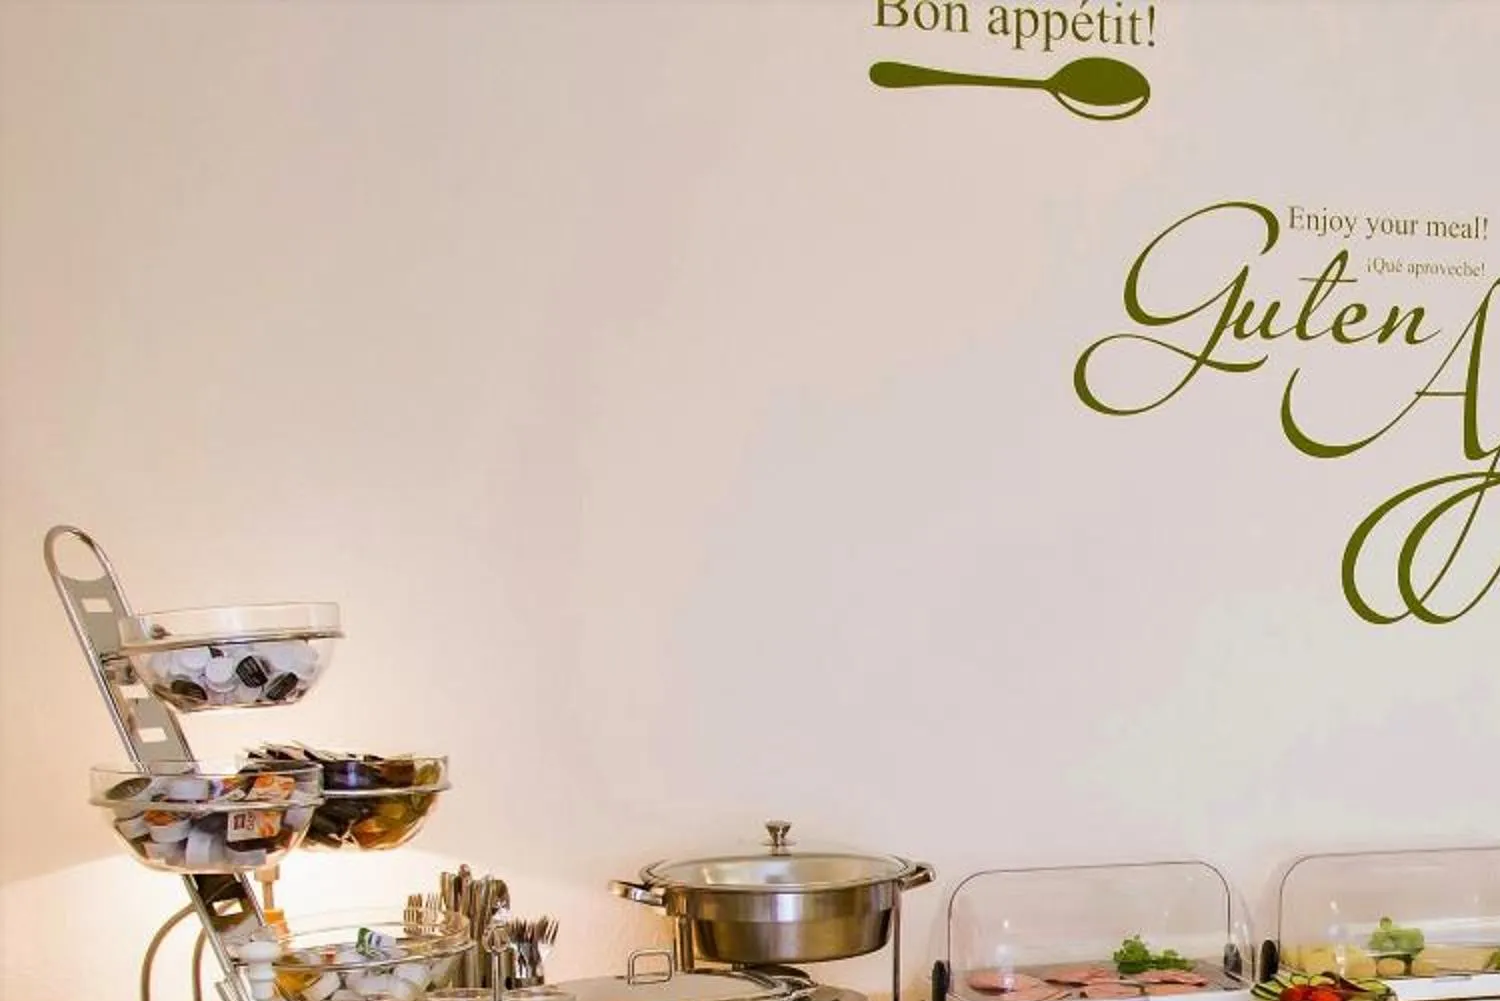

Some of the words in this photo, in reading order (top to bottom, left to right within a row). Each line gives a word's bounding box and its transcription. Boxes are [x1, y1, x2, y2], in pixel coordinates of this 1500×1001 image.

[872, 0, 969, 33] Bon
[987, 0, 1155, 52] appétit!
[1287, 205, 1357, 239] Enjoy
[1365, 216, 1419, 240] your
[1426, 215, 1489, 241] meal!
[1073, 201, 1440, 417] Guten
